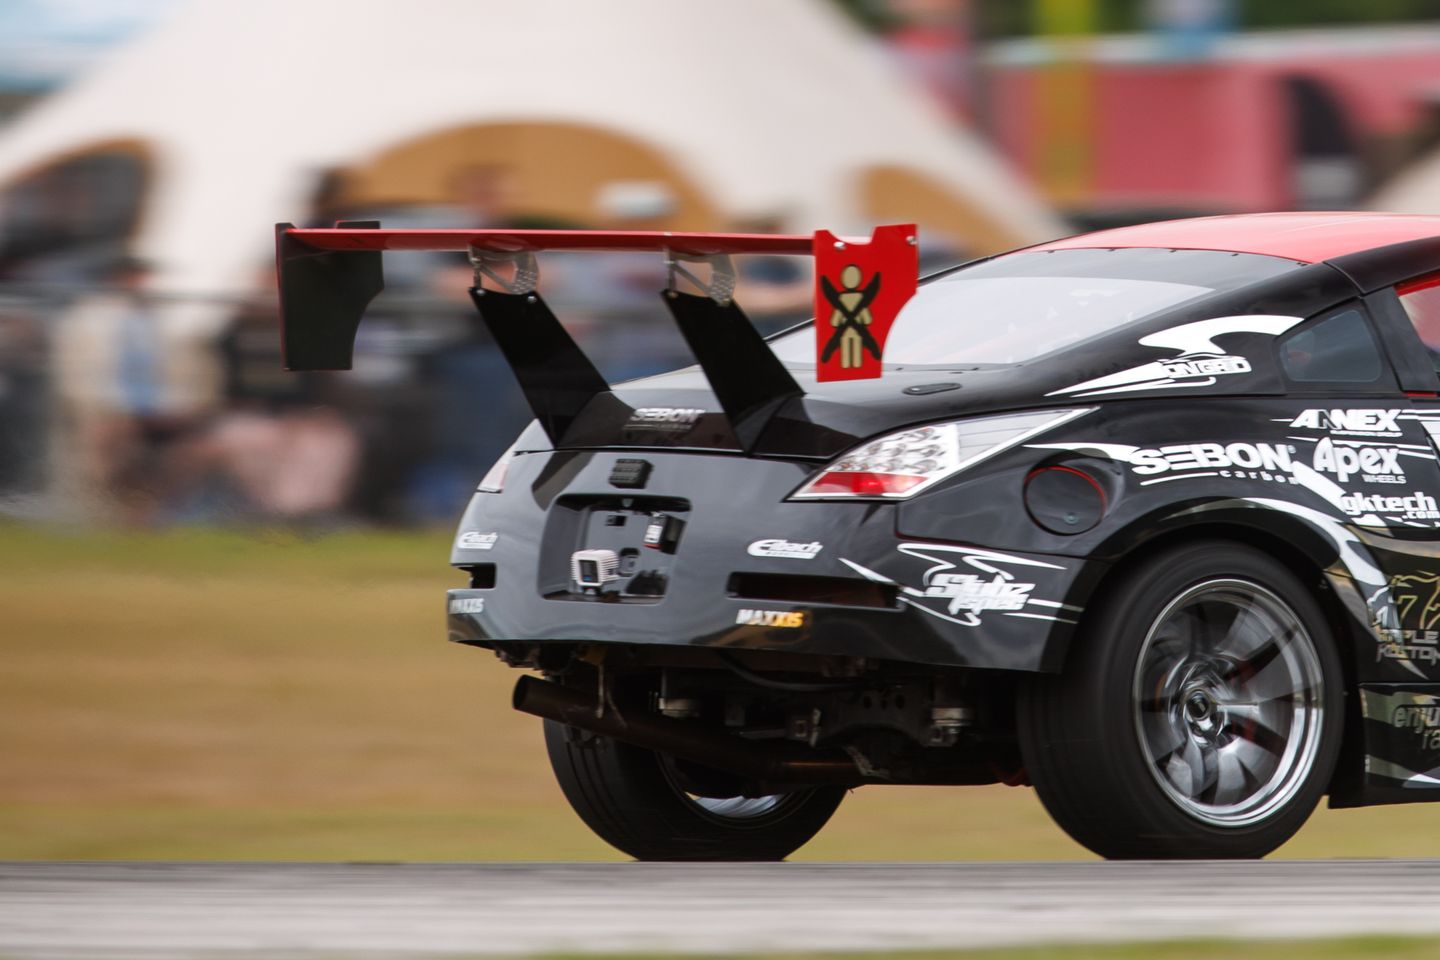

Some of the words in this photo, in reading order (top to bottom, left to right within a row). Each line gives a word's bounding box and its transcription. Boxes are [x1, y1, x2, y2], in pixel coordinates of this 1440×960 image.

[1130, 443, 1293, 475] SEBON
[1313, 437, 1405, 482] Apex
[736, 609, 805, 628] MAXXIS
